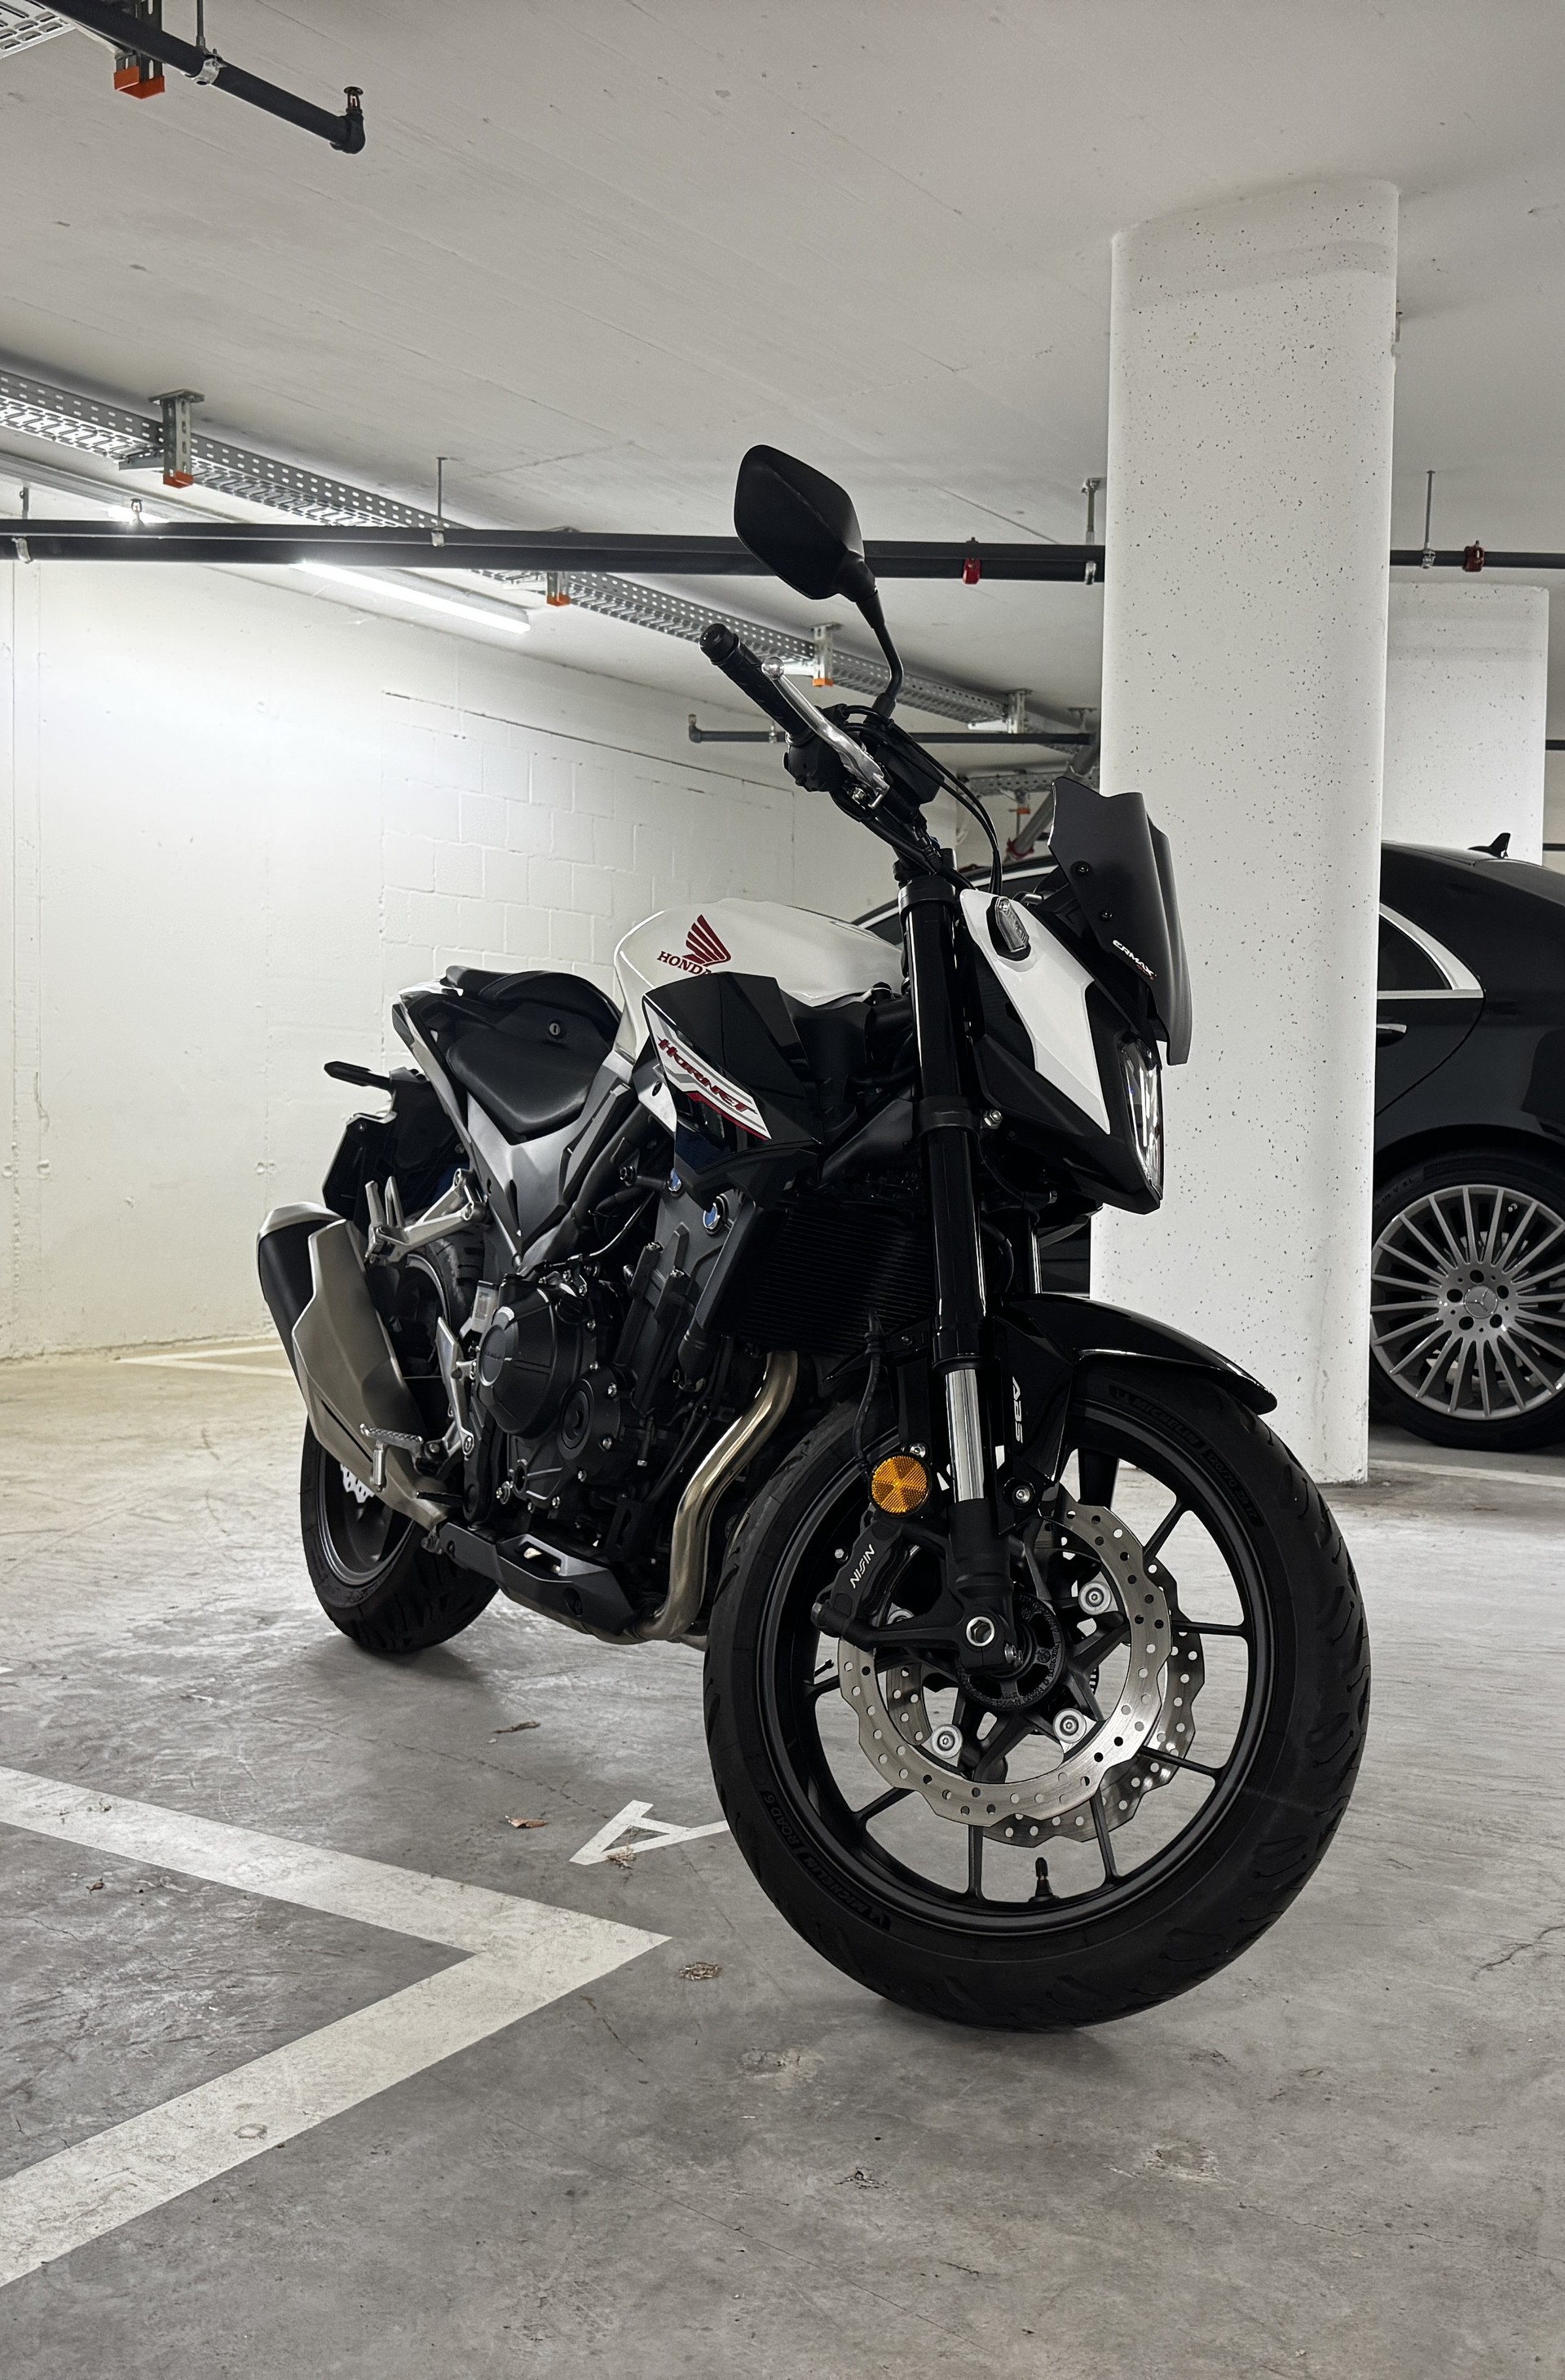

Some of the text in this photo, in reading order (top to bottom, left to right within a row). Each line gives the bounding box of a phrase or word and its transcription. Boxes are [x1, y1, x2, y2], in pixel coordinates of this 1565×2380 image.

[1112, 939, 1155, 978] ERMAX
[1012, 1375, 1024, 1444] ABS
[1131, 1398, 1200, 1448] MICHELIN
[1206, 1451, 1238, 1488] 120/70
[770, 1806, 800, 1846] ROAD
